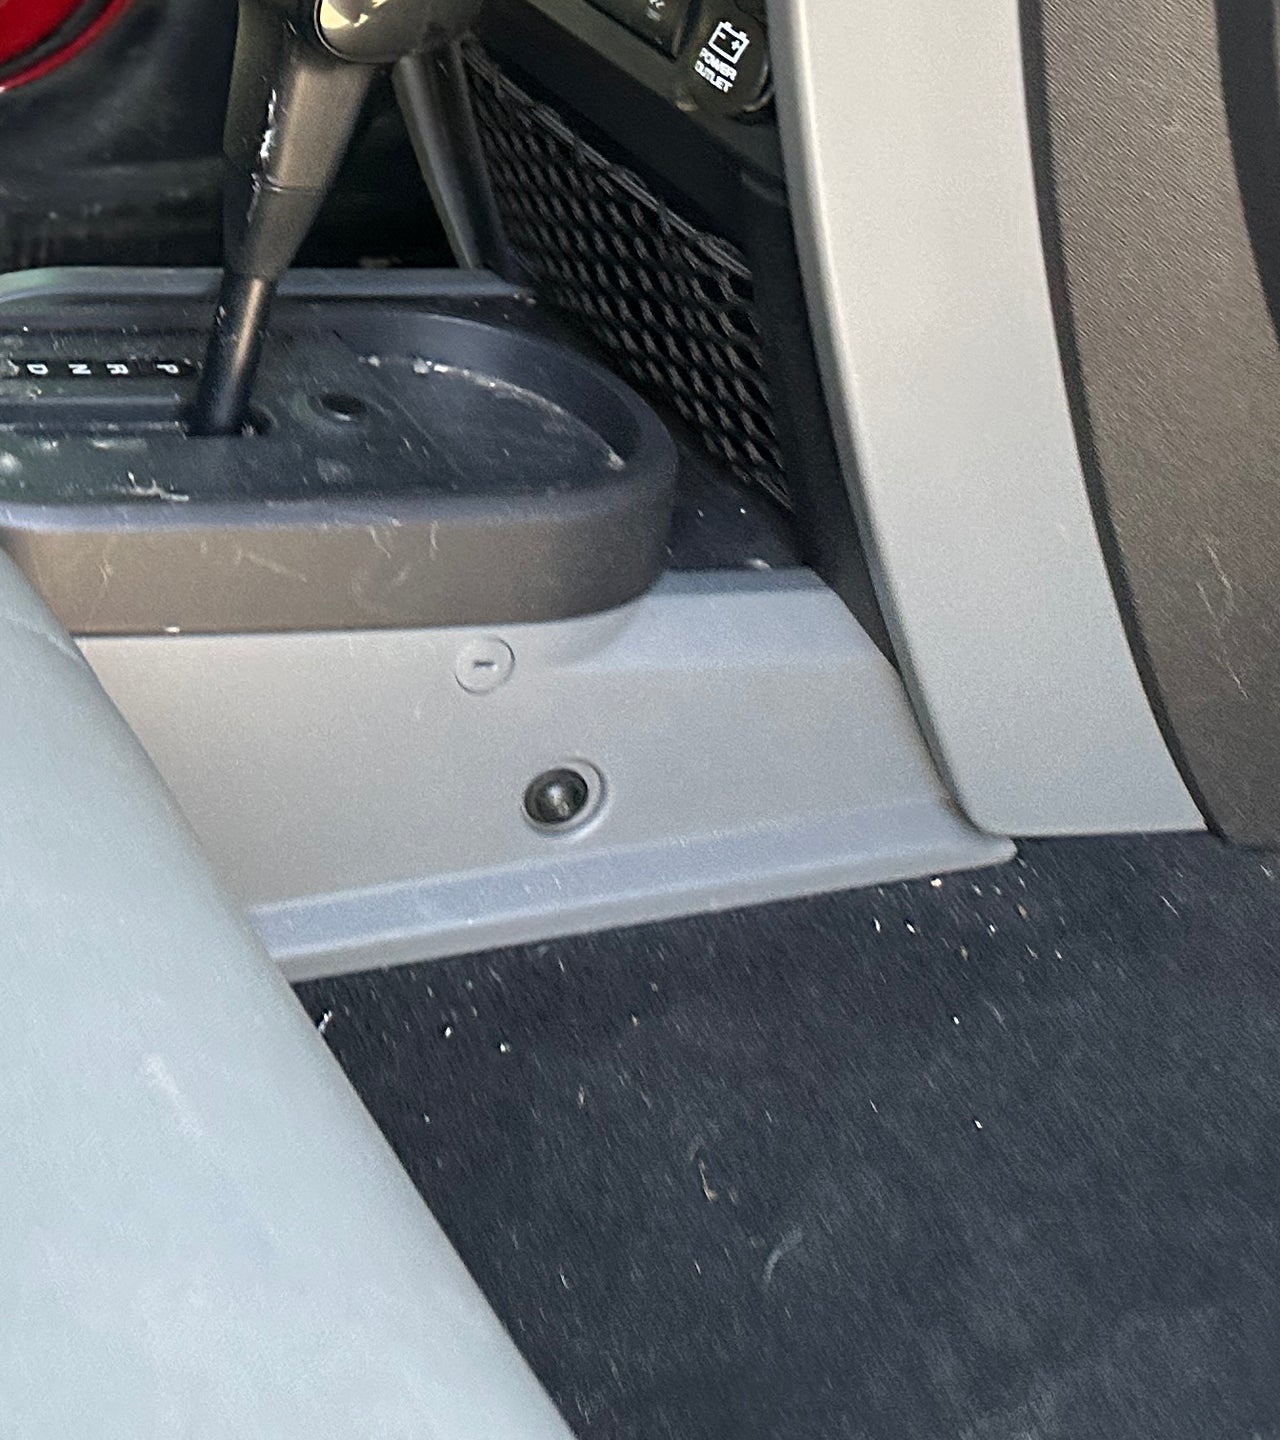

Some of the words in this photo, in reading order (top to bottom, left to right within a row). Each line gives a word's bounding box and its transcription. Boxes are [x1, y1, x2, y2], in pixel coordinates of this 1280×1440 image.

[699, 47, 737, 81] POWER
[694, 60, 733, 93] OUTLET
[26, 363, 48, 375] D
[67, 363, 92, 375] N
[106, 363, 129, 375] R
[156, 363, 179, 374] P
